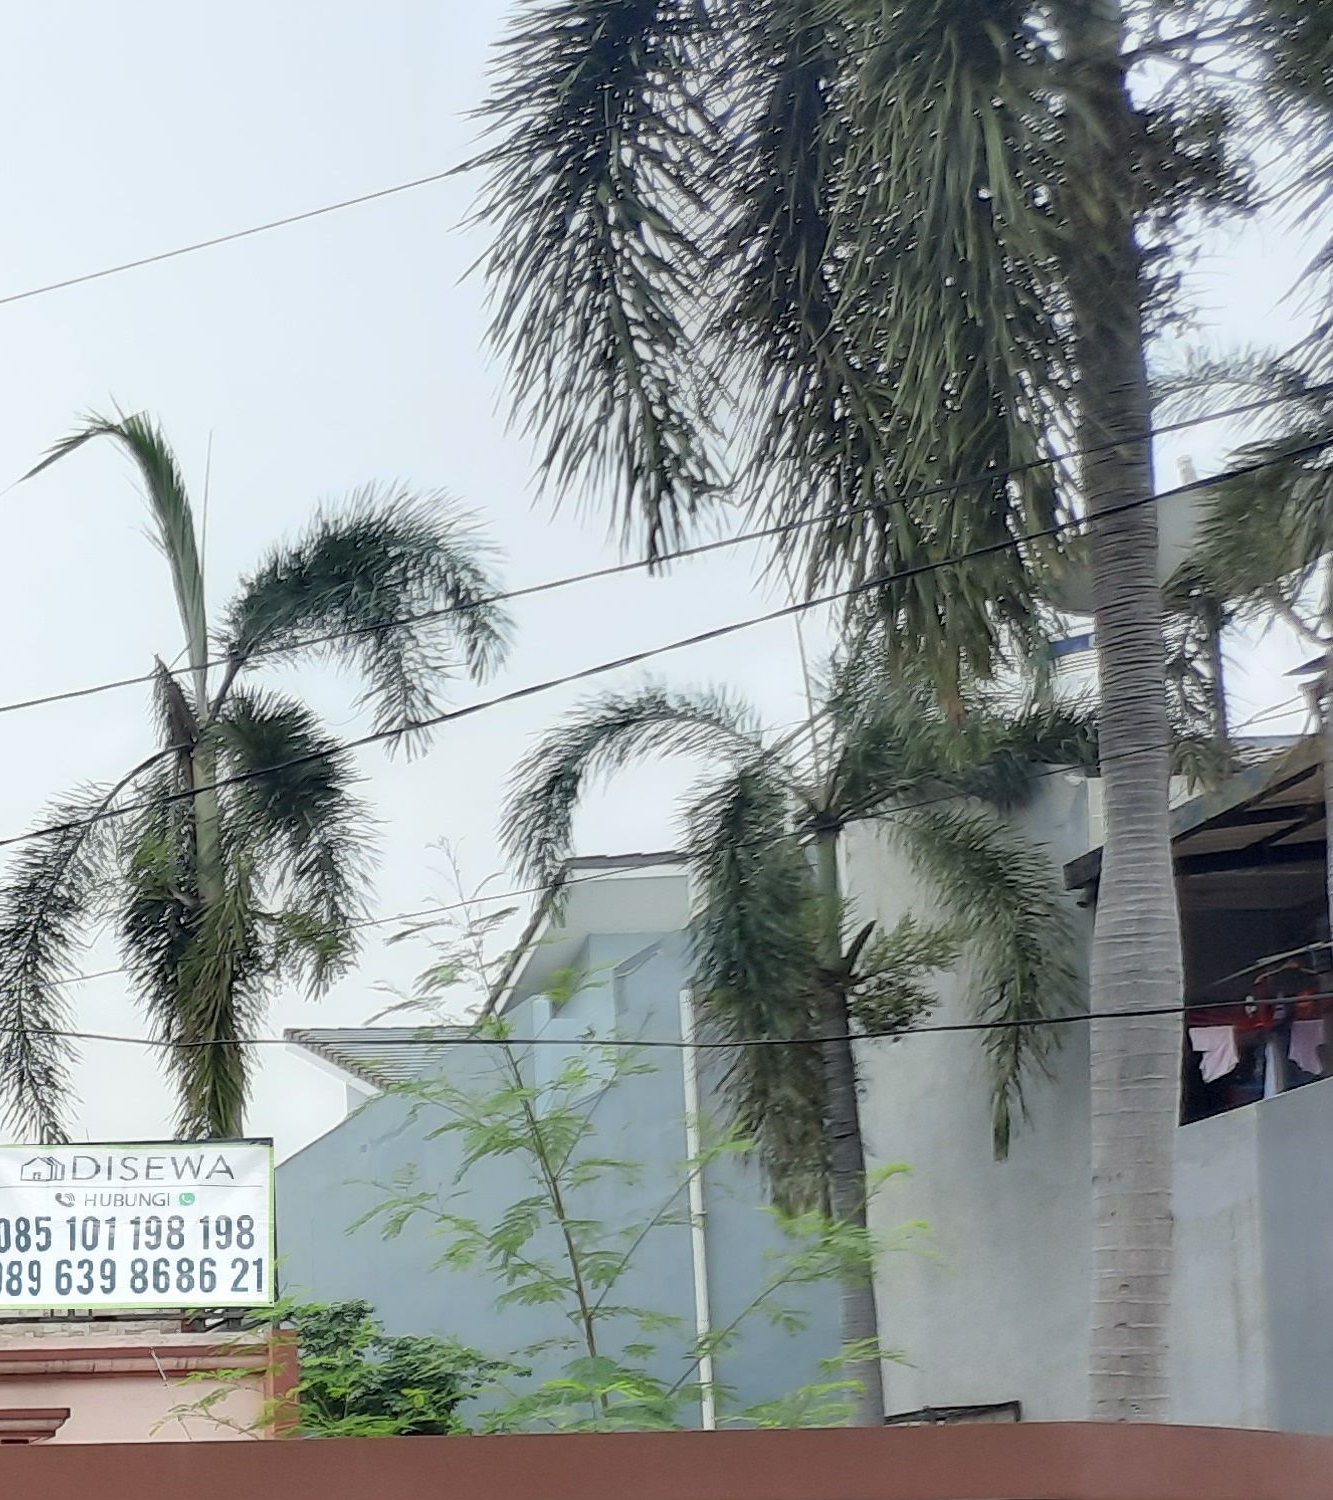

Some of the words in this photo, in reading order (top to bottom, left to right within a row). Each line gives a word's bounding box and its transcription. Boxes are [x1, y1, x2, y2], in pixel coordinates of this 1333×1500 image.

[72, 1155, 234, 1181] DISEWA
[84, 1192, 170, 1207] HUBUNGI
[66, 1216, 116, 1251] 101
[130, 1215, 184, 1250] 198
[200, 1215, 254, 1249] 198
[55, 1259, 116, 1295] 639
[130, 1257, 216, 1294] 8686
[231, 1258, 262, 1292] 21
